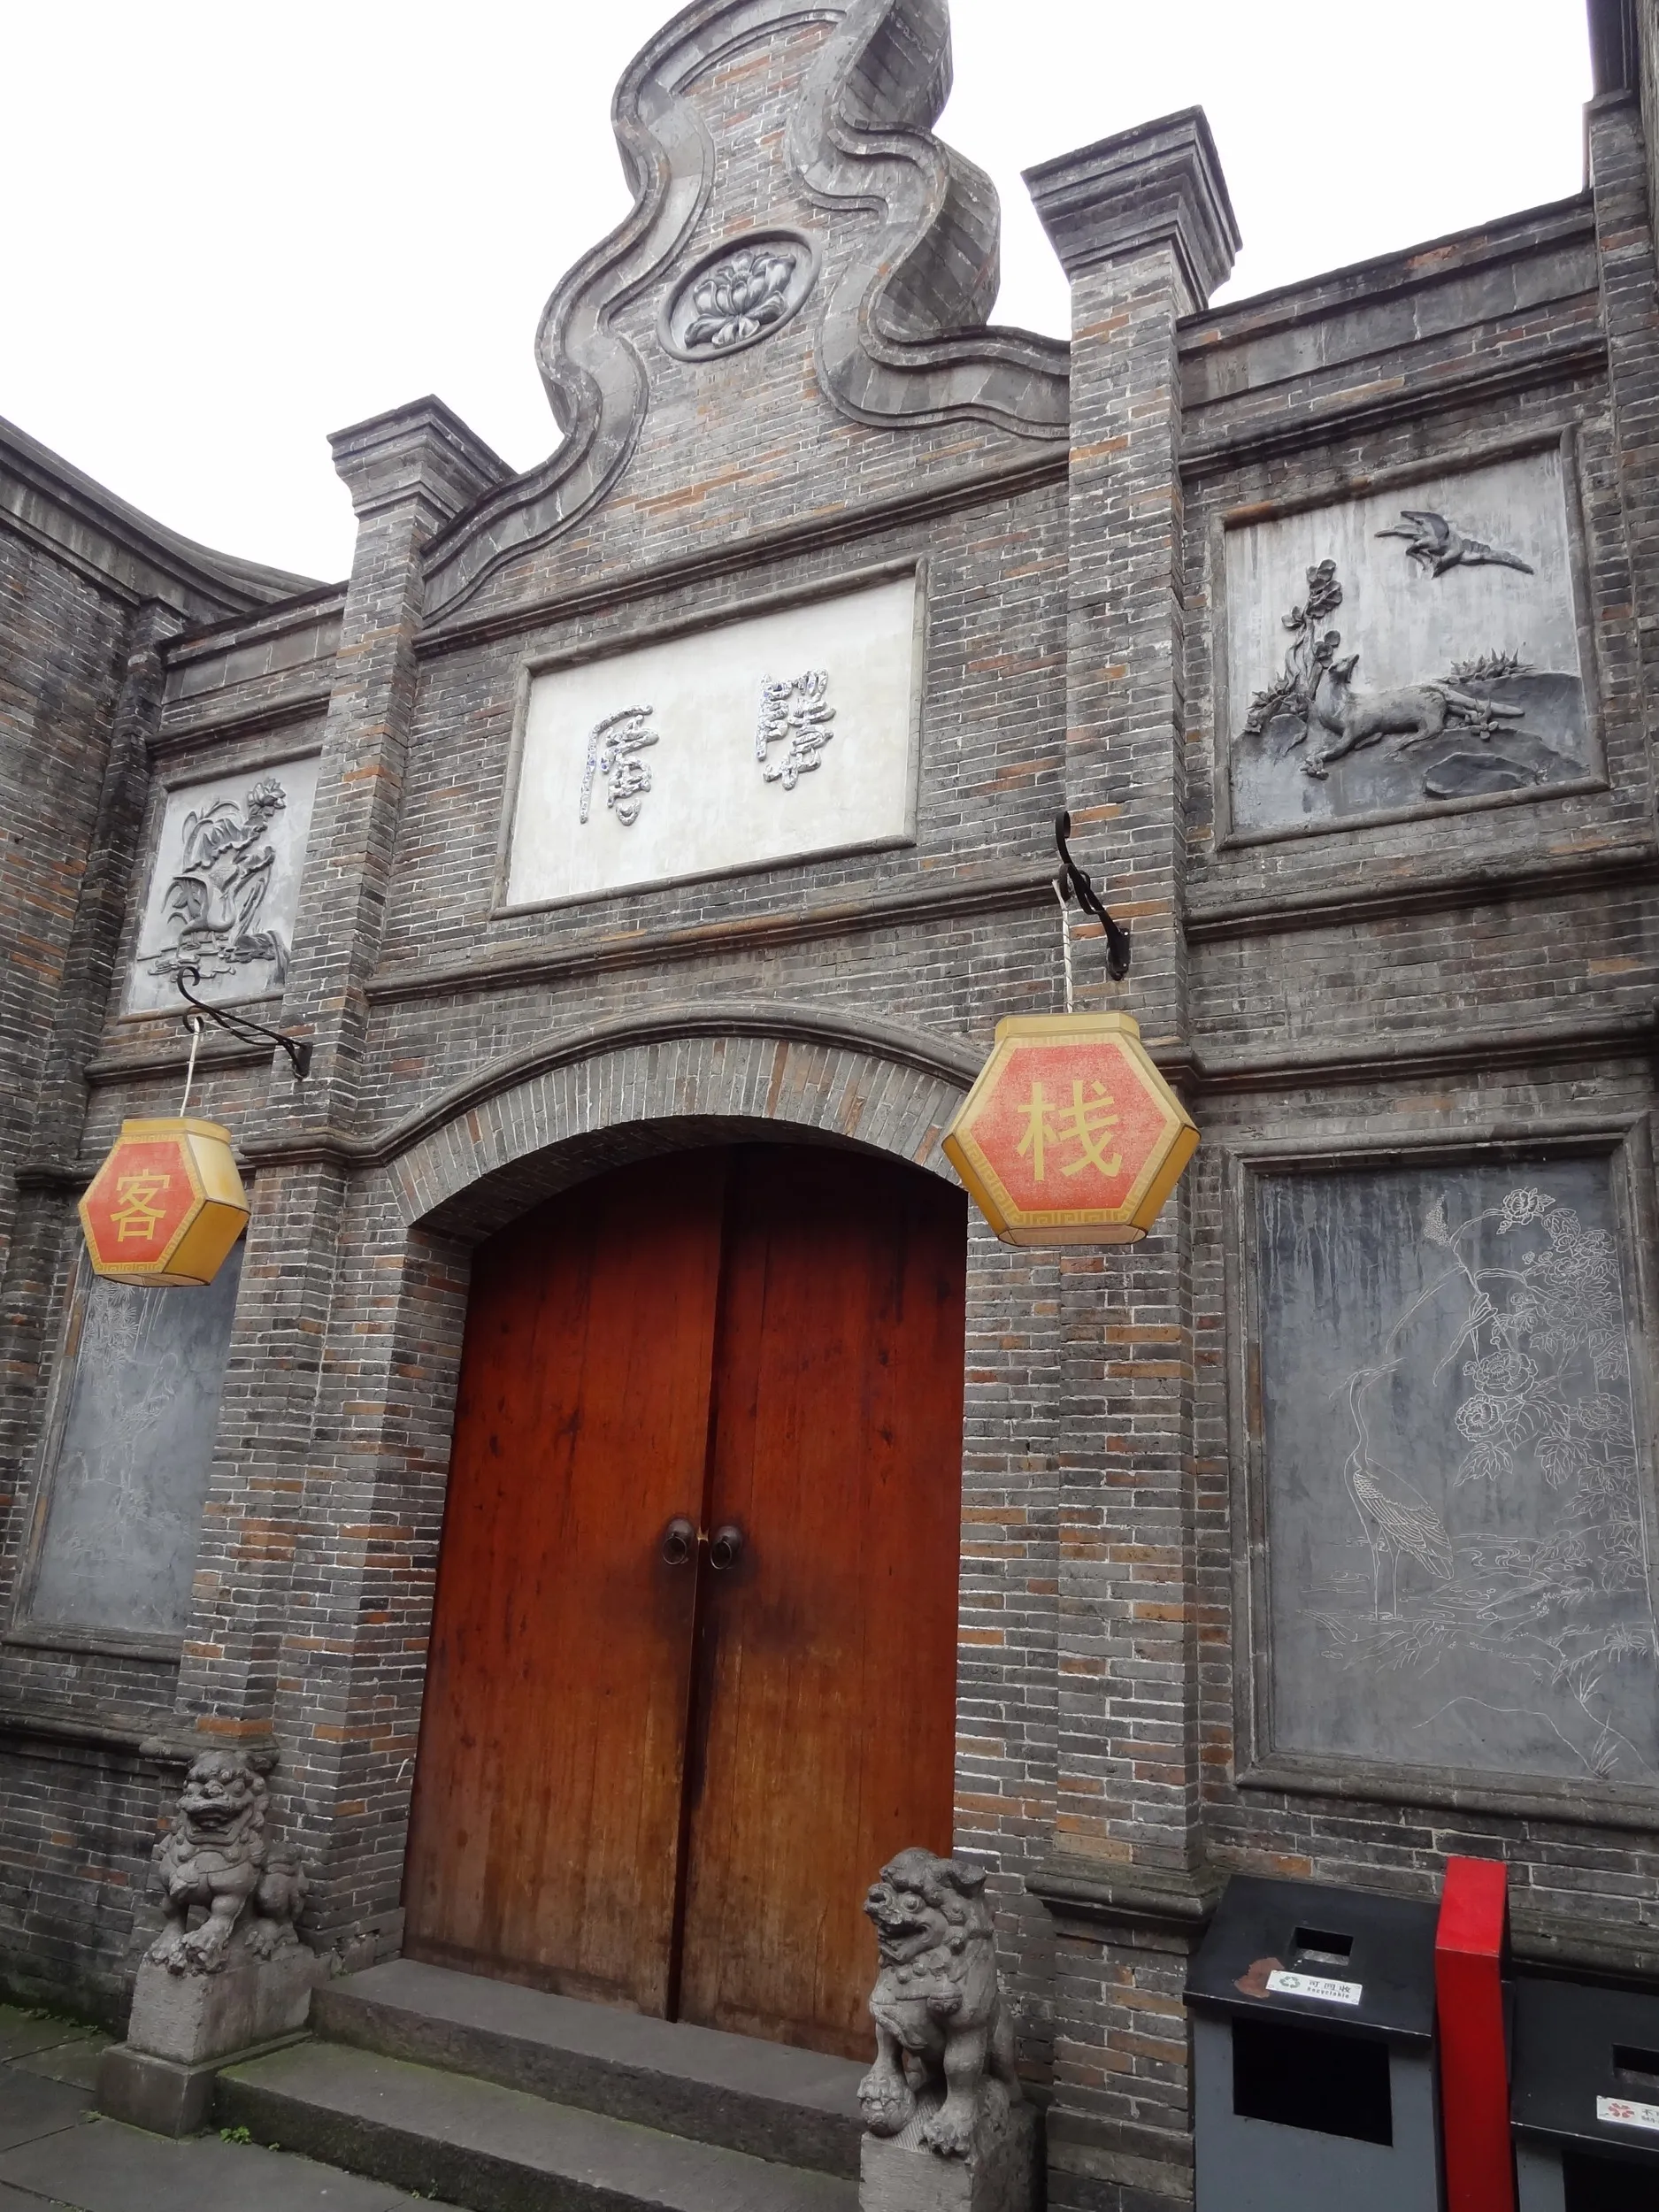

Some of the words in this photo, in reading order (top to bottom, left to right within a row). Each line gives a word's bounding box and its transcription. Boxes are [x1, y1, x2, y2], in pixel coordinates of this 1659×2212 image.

[1017, 1079, 1122, 1181] 栈
[110, 1169, 170, 1242] 客
[1309, 1981, 1351, 1993] 可回收
